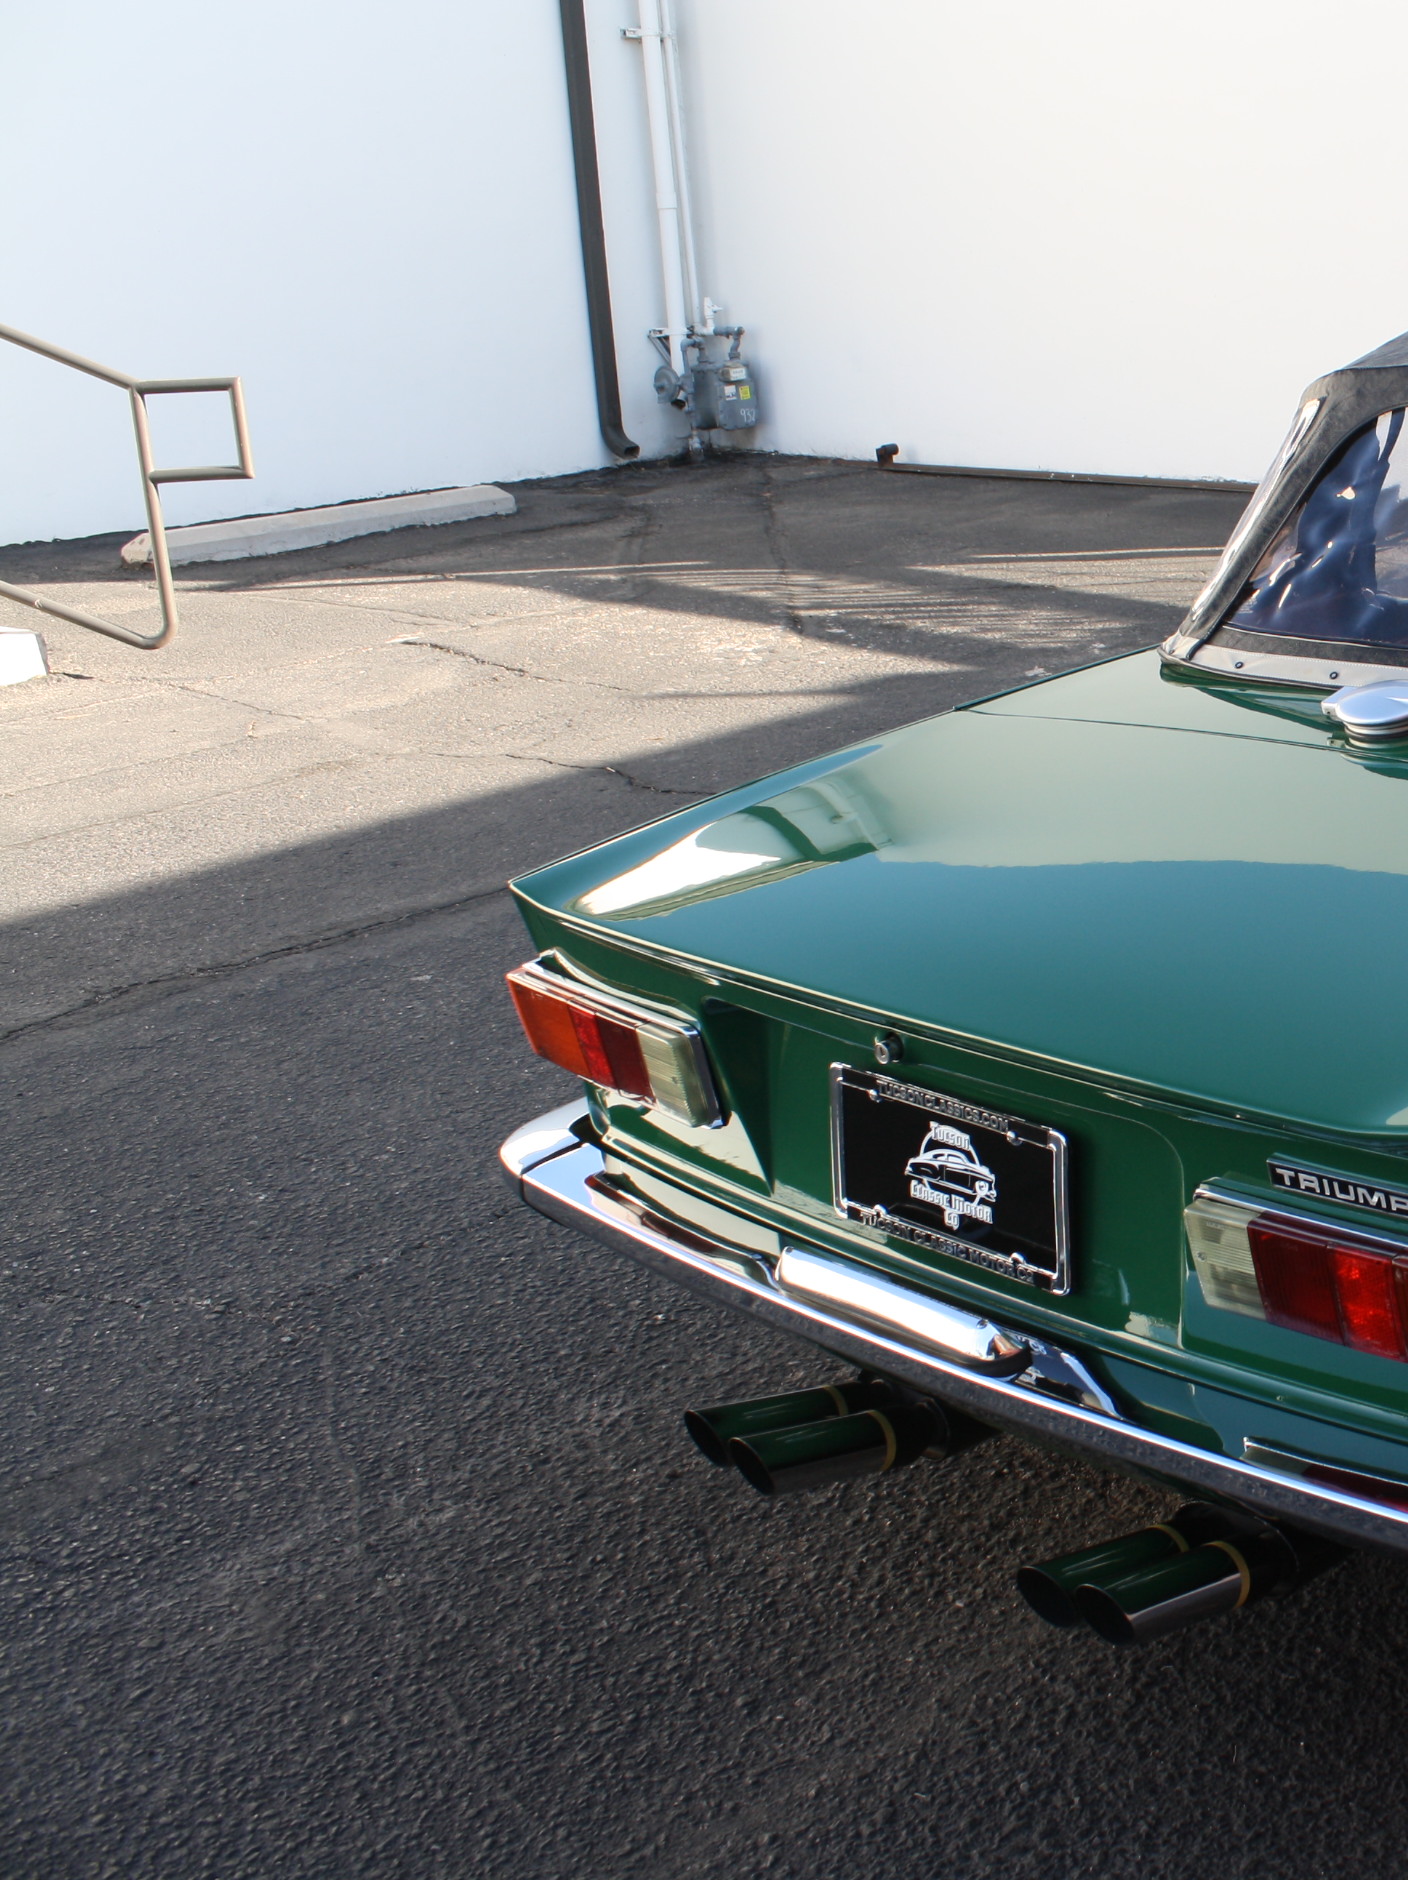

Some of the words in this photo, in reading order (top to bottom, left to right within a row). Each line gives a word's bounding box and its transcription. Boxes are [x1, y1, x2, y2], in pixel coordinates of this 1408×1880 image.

[876, 1079, 1009, 1133] TUCSONCLASSICS.COM
[929, 1121, 971, 1151] TUCSON
[910, 1179, 951, 1207] CLASSIC
[950, 1193, 994, 1224] MOTOR
[860, 1212, 912, 1241] TUCSON
[914, 1230, 967, 1258] CLASSIC
[969, 1248, 1016, 1277] MOTOR
